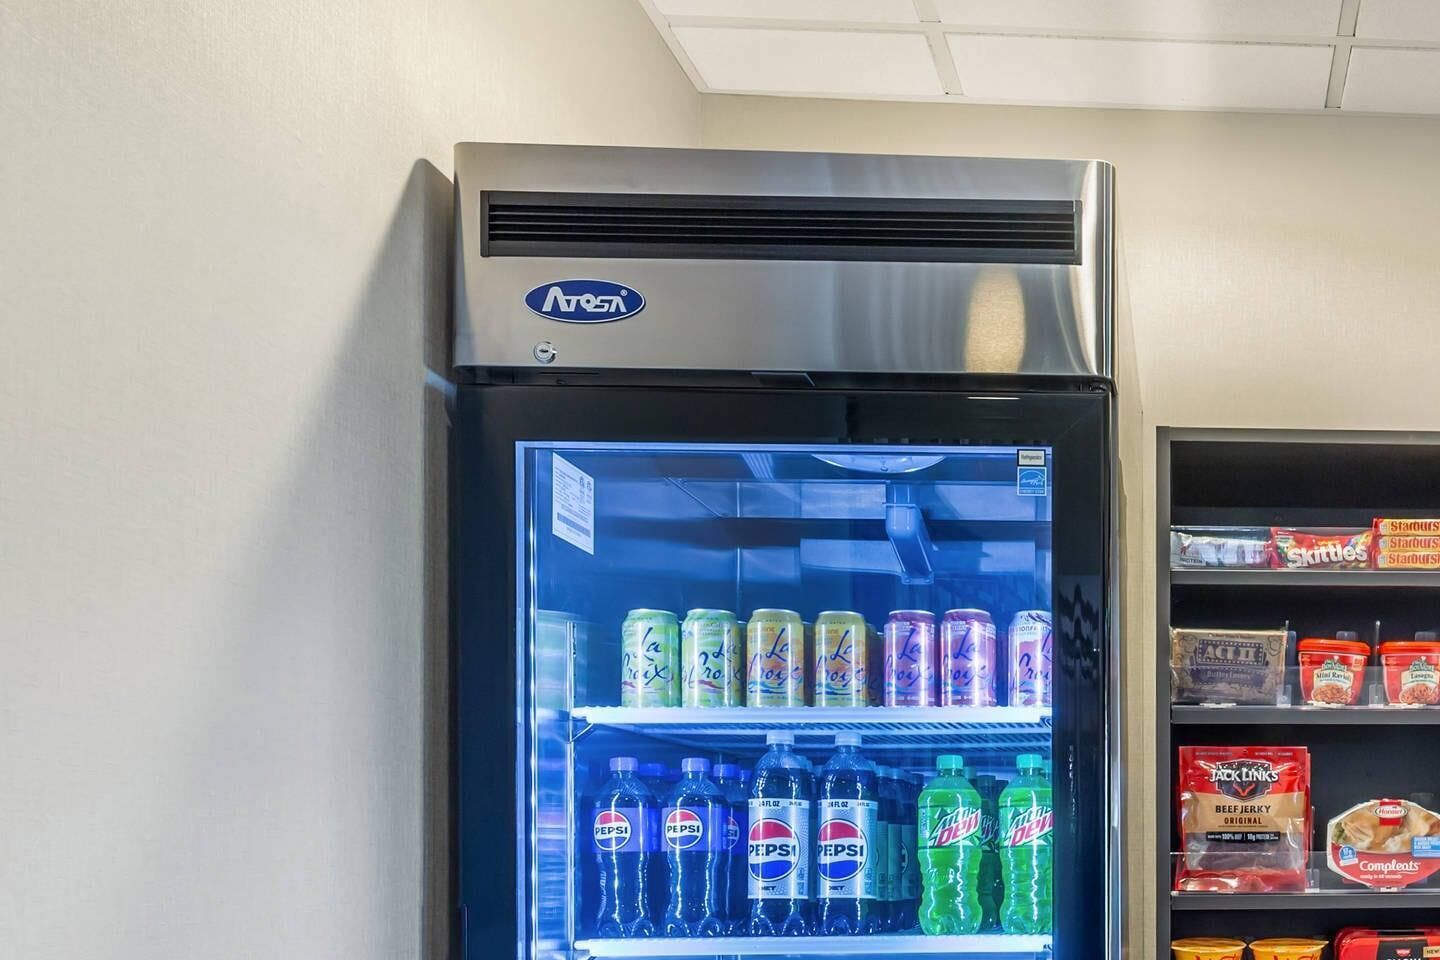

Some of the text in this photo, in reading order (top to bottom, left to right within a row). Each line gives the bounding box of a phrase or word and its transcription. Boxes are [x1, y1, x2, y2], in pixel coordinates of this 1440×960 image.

[1287, 545, 1367, 569] Skittles
[1389, 552, 1440, 565] Starburst
[1204, 647, 1234, 660] ACT
[1216, 805, 1271, 814] BEEF JERKY
[1224, 817, 1262, 825] ORIGINAL
[595, 826, 628, 836] PEPSI
[667, 825, 700, 834] PEPSI
[1359, 860, 1421, 873] Compleats
